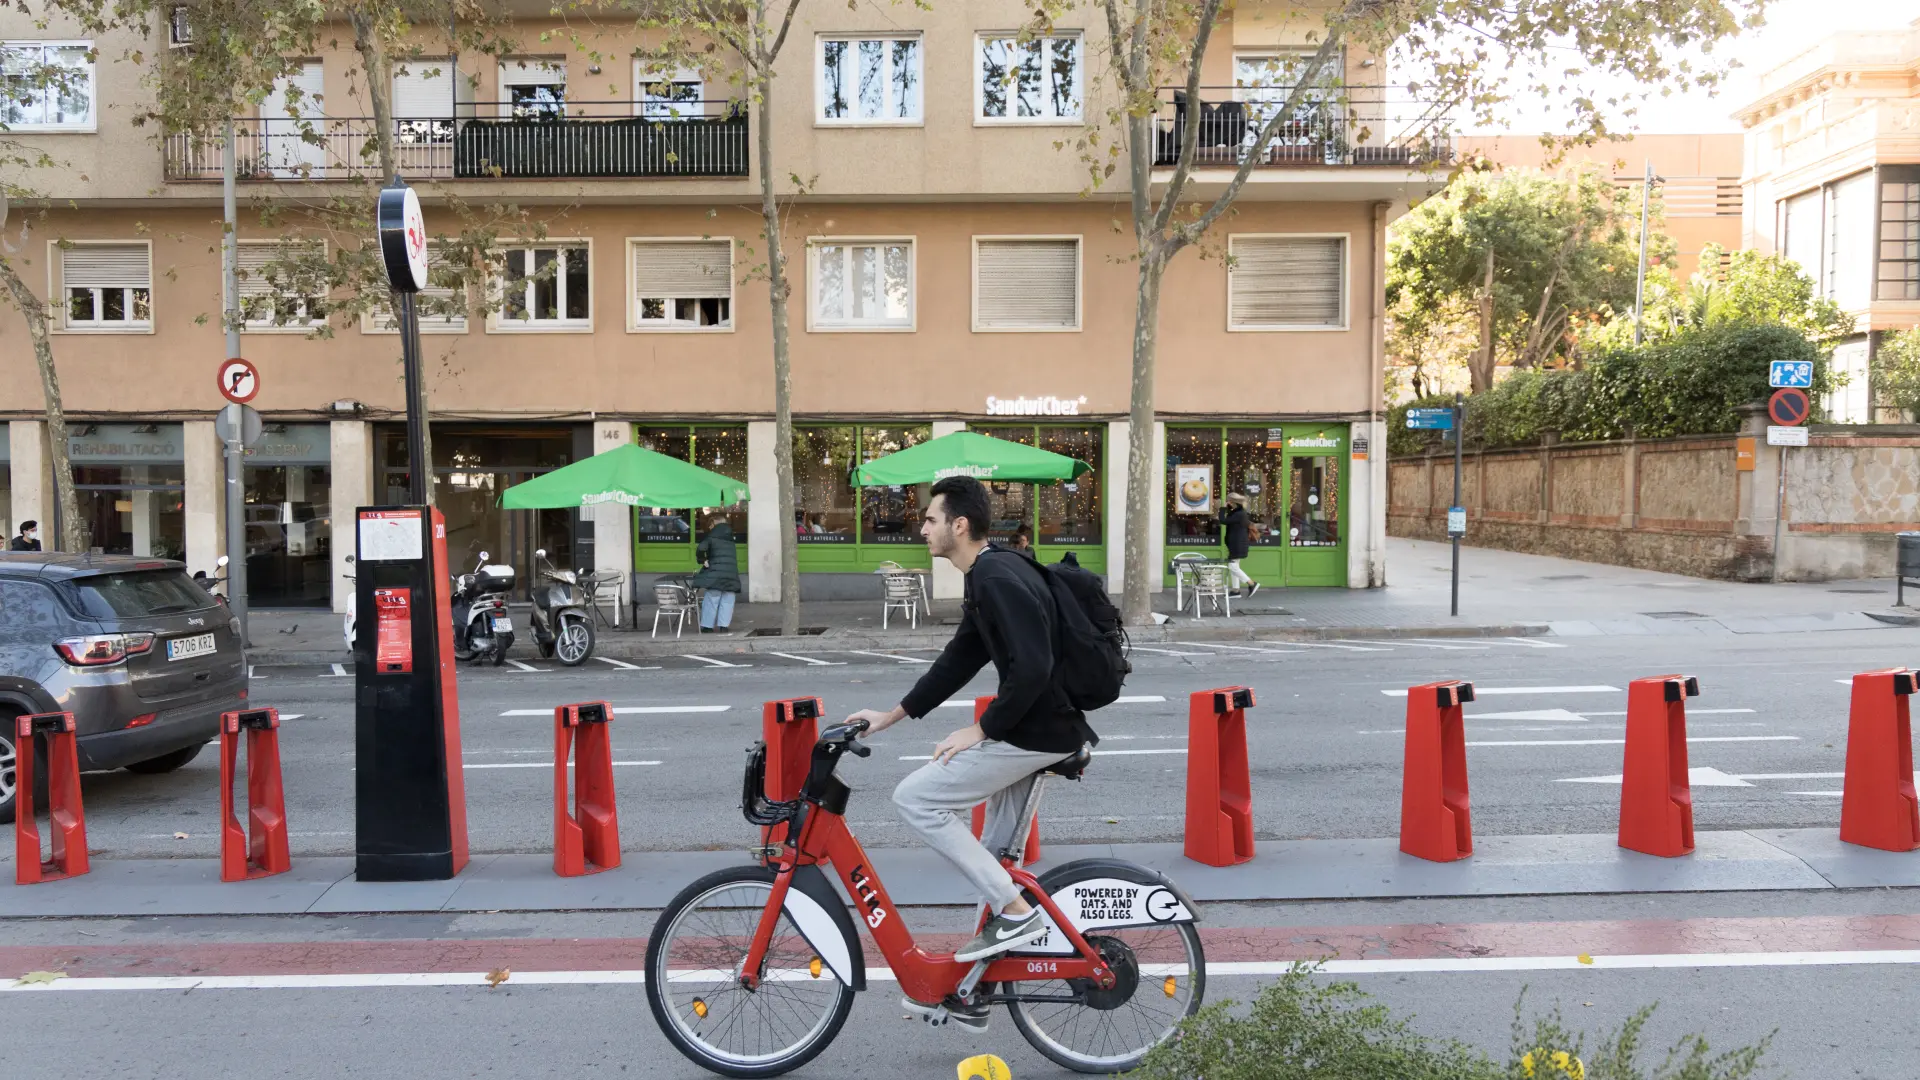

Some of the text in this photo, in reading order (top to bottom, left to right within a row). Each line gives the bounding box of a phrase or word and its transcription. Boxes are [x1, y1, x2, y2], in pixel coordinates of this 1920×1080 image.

[986, 396, 1079, 415] SandwiChez
[72, 441, 175, 455] REHABILITACIÓ
[581, 490, 638, 505] SandwiChez
[188, 618, 204, 626] Jeep
[173, 635, 213, 654] 5706 KRZ
[850, 863, 887, 929] bicing
[1075, 888, 1139, 899] POWERED BY
[1082, 899, 1132, 909] OATS. AND
[1080, 909, 1134, 919] ALSO LEGS.
[1027, 962, 1057, 973] 0614
